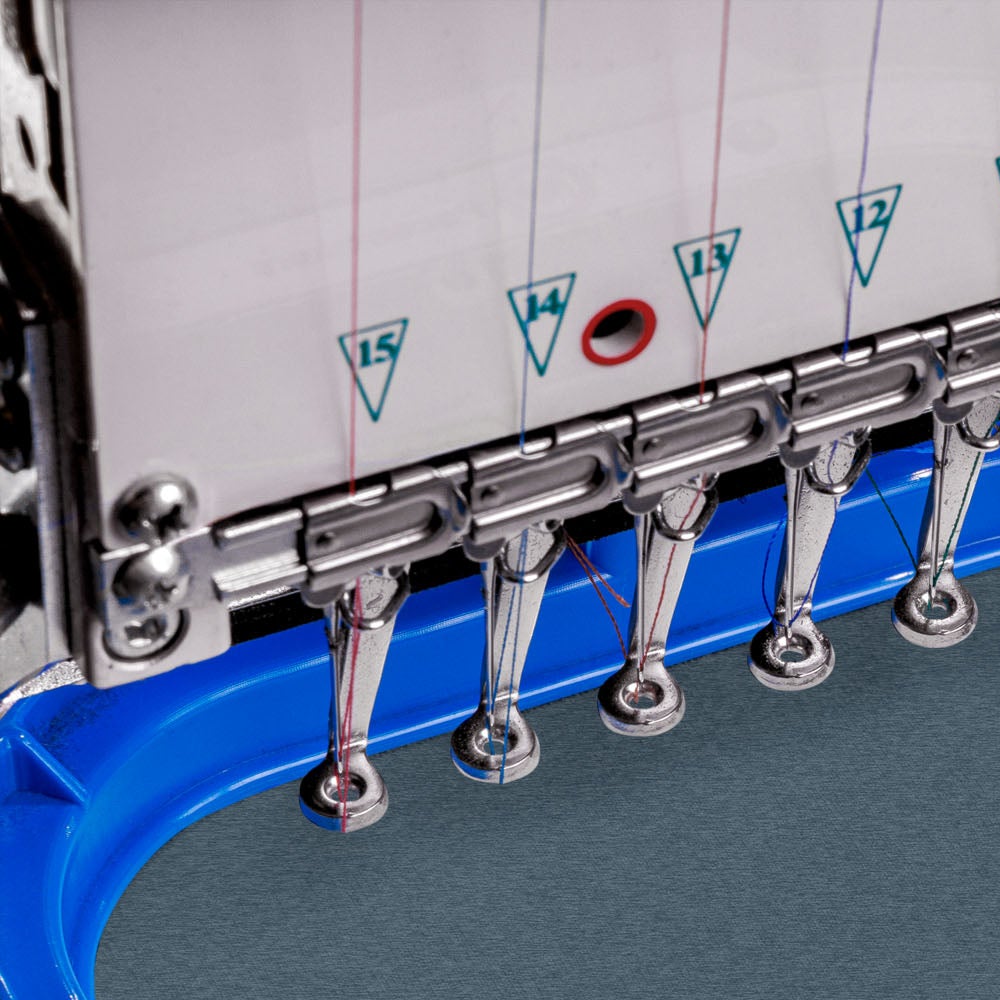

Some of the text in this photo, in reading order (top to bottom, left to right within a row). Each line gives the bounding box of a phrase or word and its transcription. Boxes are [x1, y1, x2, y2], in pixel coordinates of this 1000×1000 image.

[852, 199, 891, 234] 12
[690, 242, 729, 277] 13
[526, 286, 565, 322] 14
[358, 330, 399, 367] 15
